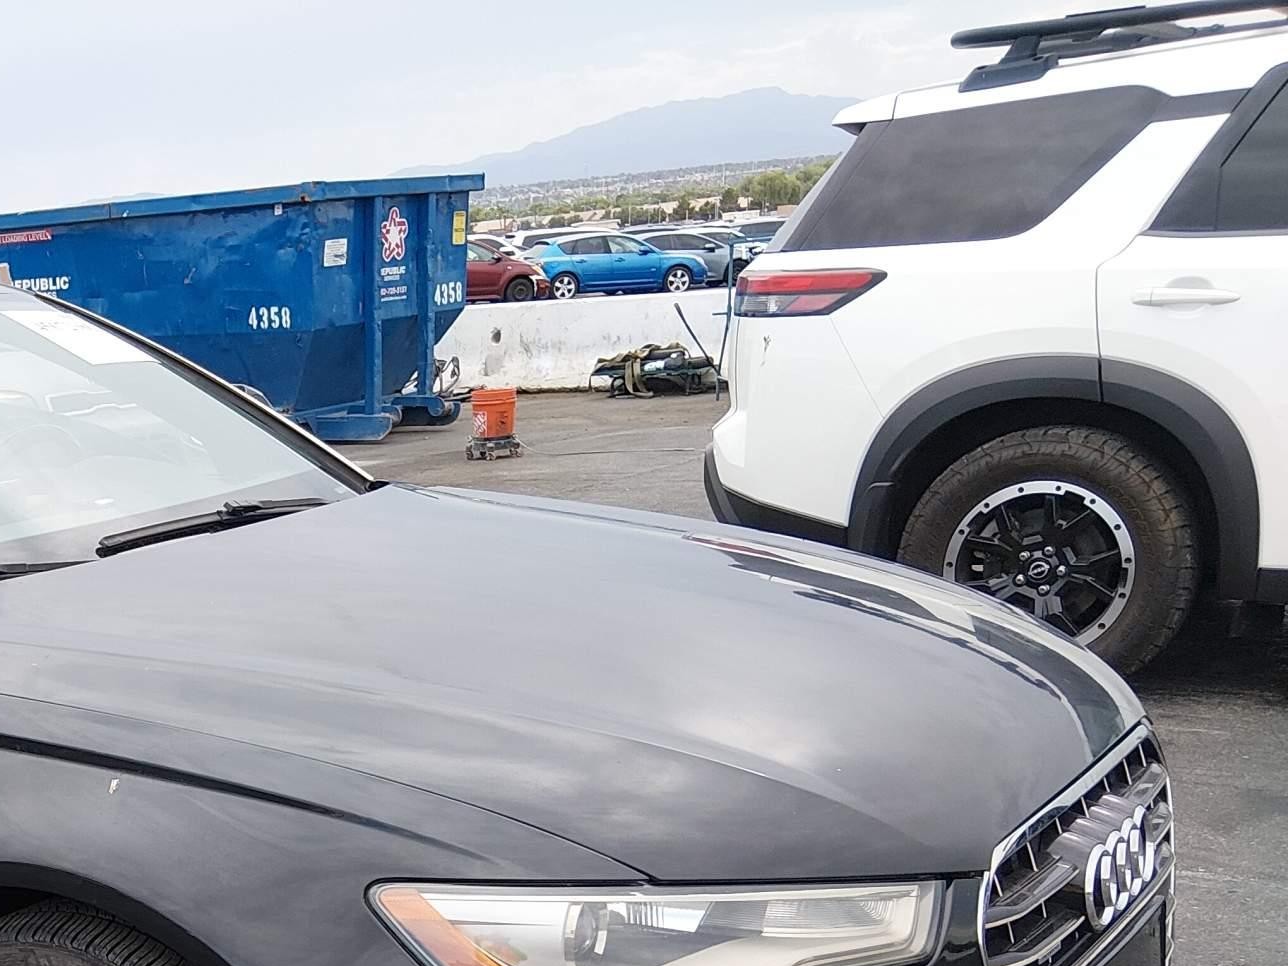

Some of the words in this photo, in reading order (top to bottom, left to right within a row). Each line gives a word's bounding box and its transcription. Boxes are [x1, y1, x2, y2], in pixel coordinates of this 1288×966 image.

[29, 232, 48, 241] LEVEL
[13, 276, 69, 291] EPUBLIC
[434, 281, 462, 306] 4358
[248, 306, 291, 330] 4358
